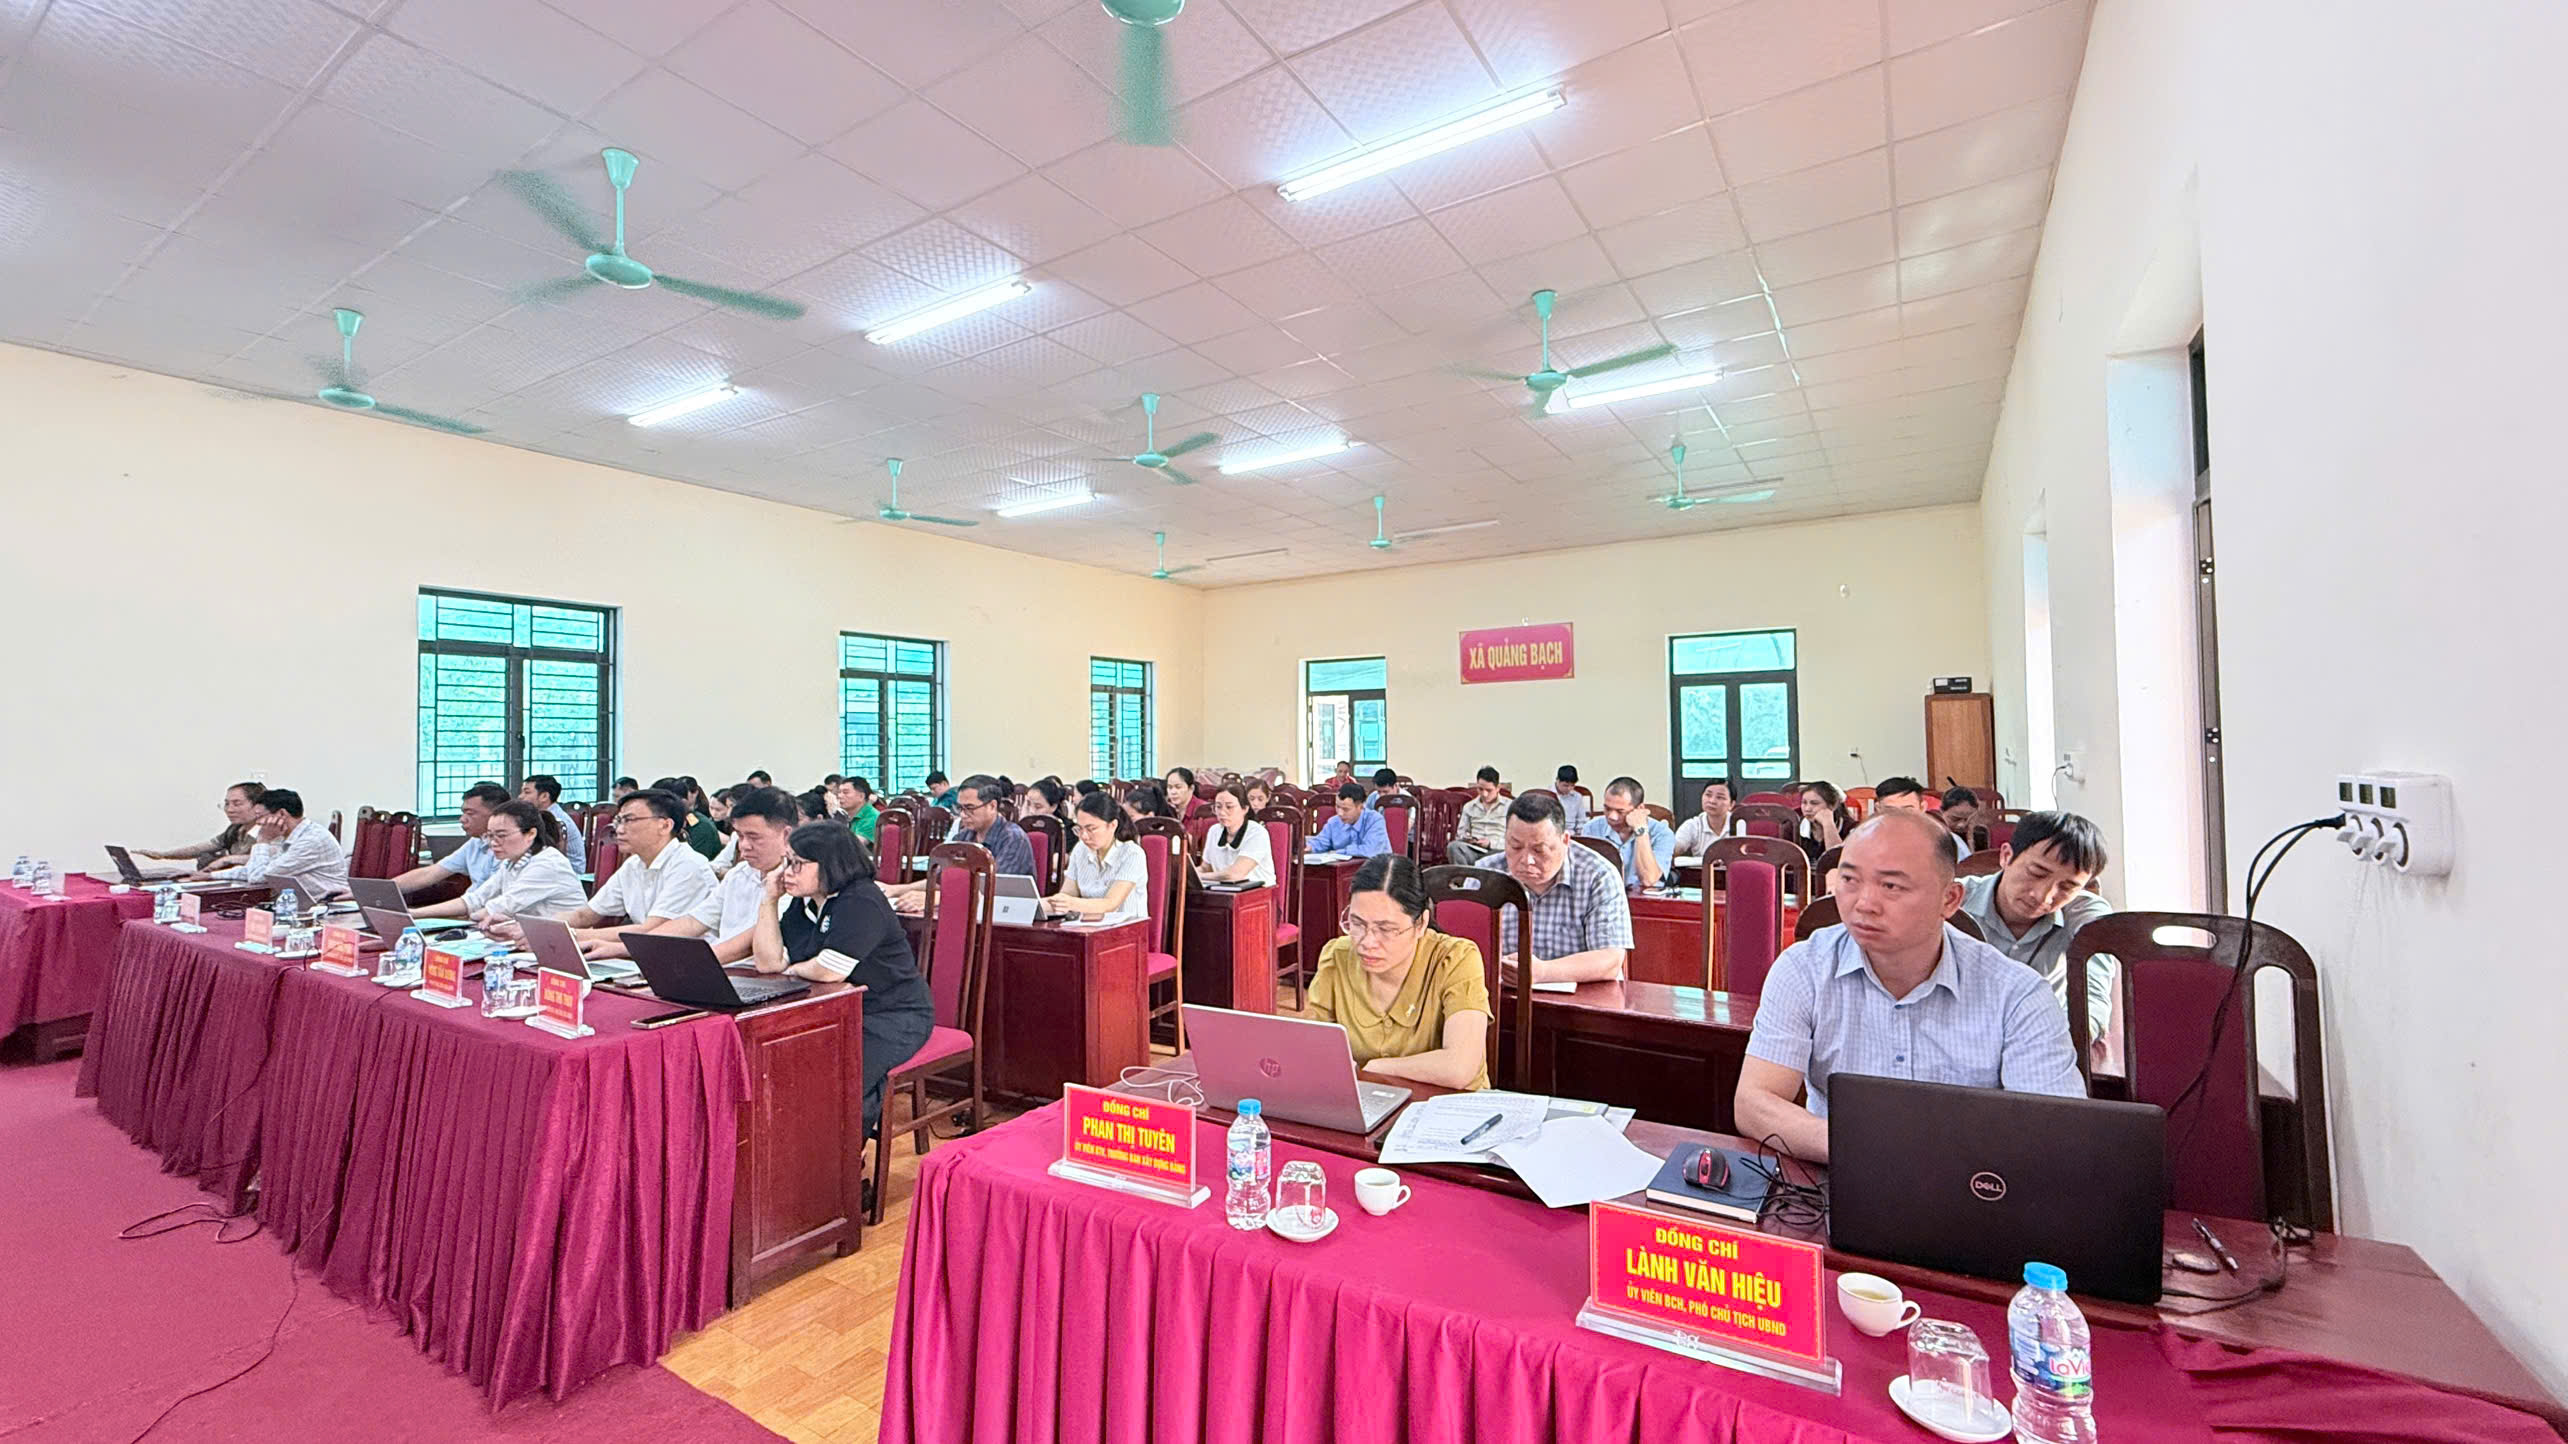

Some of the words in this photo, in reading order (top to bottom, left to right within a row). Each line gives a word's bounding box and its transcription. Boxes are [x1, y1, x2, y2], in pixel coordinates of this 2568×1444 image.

[1469, 642, 1486, 669] XÃ
[1488, 637, 1528, 671] QUẢNG
[1530, 640, 1563, 670] BẠCH
[1083, 1116, 1114, 1140] PHAN
[1117, 1123, 1136, 1149] THỊ
[1974, 1180, 2003, 1193] DELL
[1707, 1239, 1739, 1260] CHÍ
[1626, 1245, 1679, 1285] LÀNH
[1683, 1259, 1726, 1296] VĂN
[1732, 1272, 1782, 1311] HIỆU
[1641, 1287, 1663, 1307] VIÊN
[1688, 1299, 1709, 1318] PHÓ
[1710, 1303, 1731, 1323] CHỦ
[1733, 1311, 1756, 1329] TỊCH
